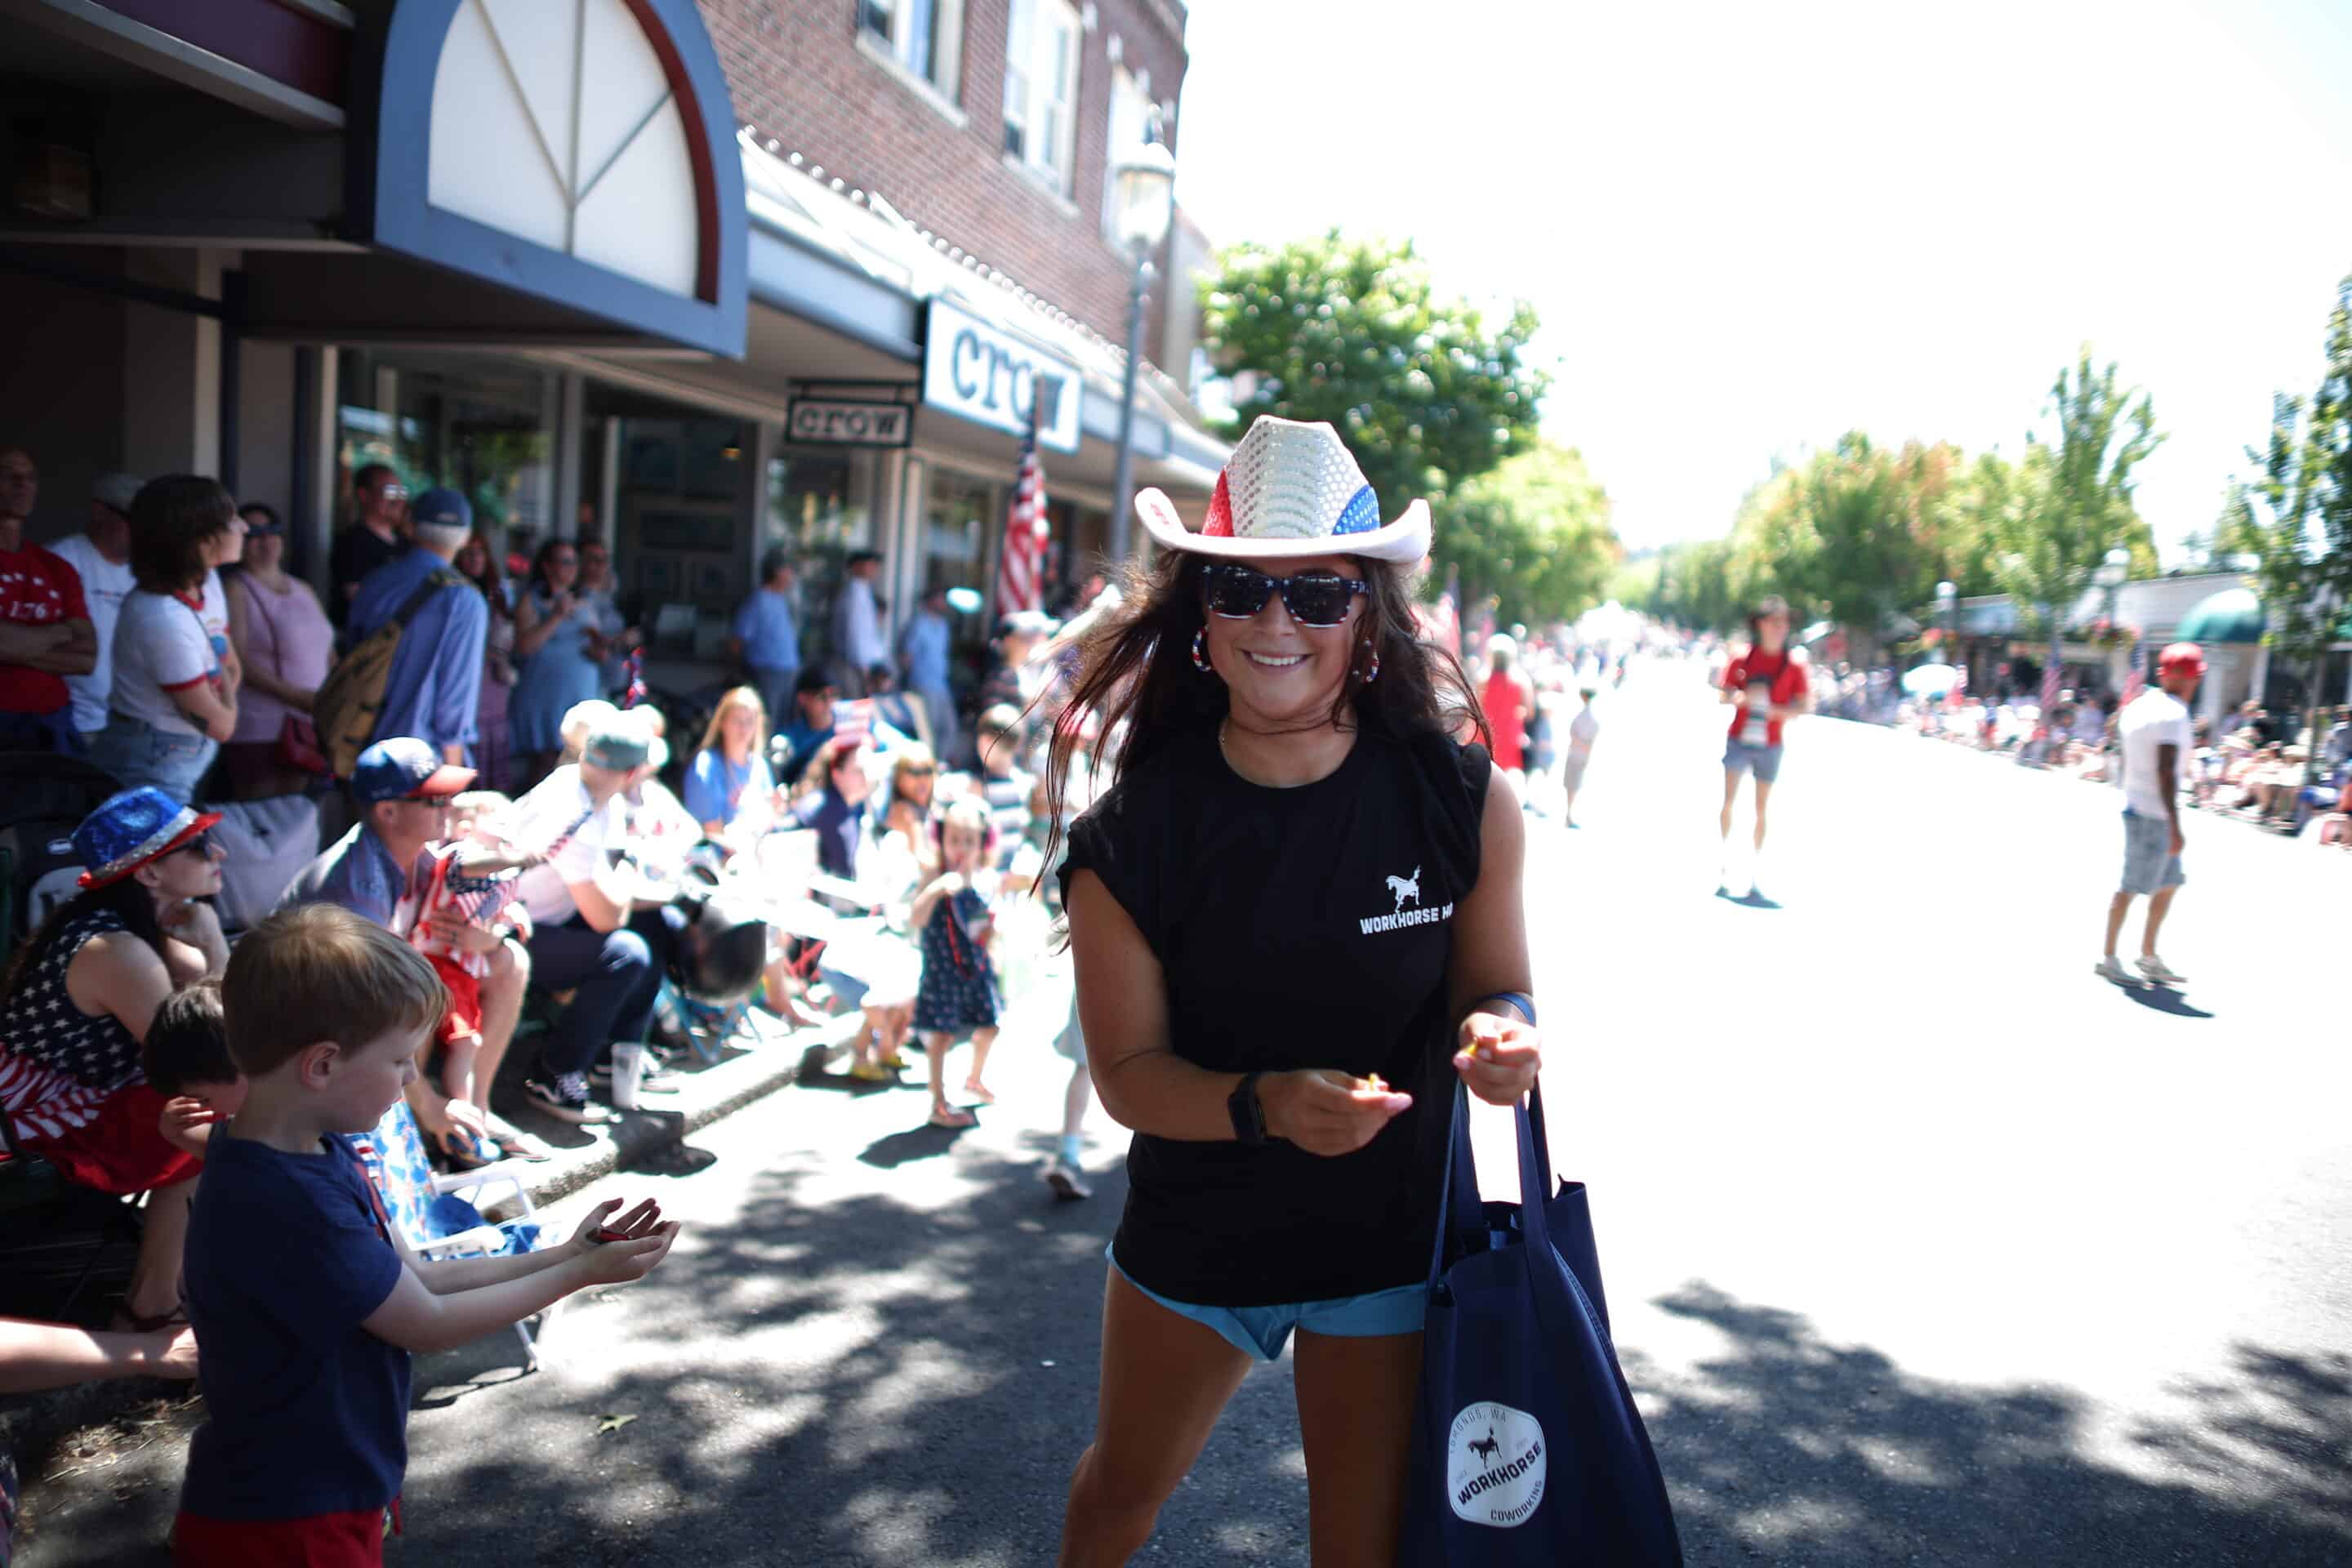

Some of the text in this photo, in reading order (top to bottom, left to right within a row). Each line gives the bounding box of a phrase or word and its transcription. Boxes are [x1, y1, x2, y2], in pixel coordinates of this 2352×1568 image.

[951, 328, 1067, 431] crow
[798, 409, 898, 435] crow
[1359, 907, 1439, 935] WORKHORSE
[1457, 1440, 1542, 1506] WORKHORSE
[1490, 1479, 1543, 1522] COWORKING
